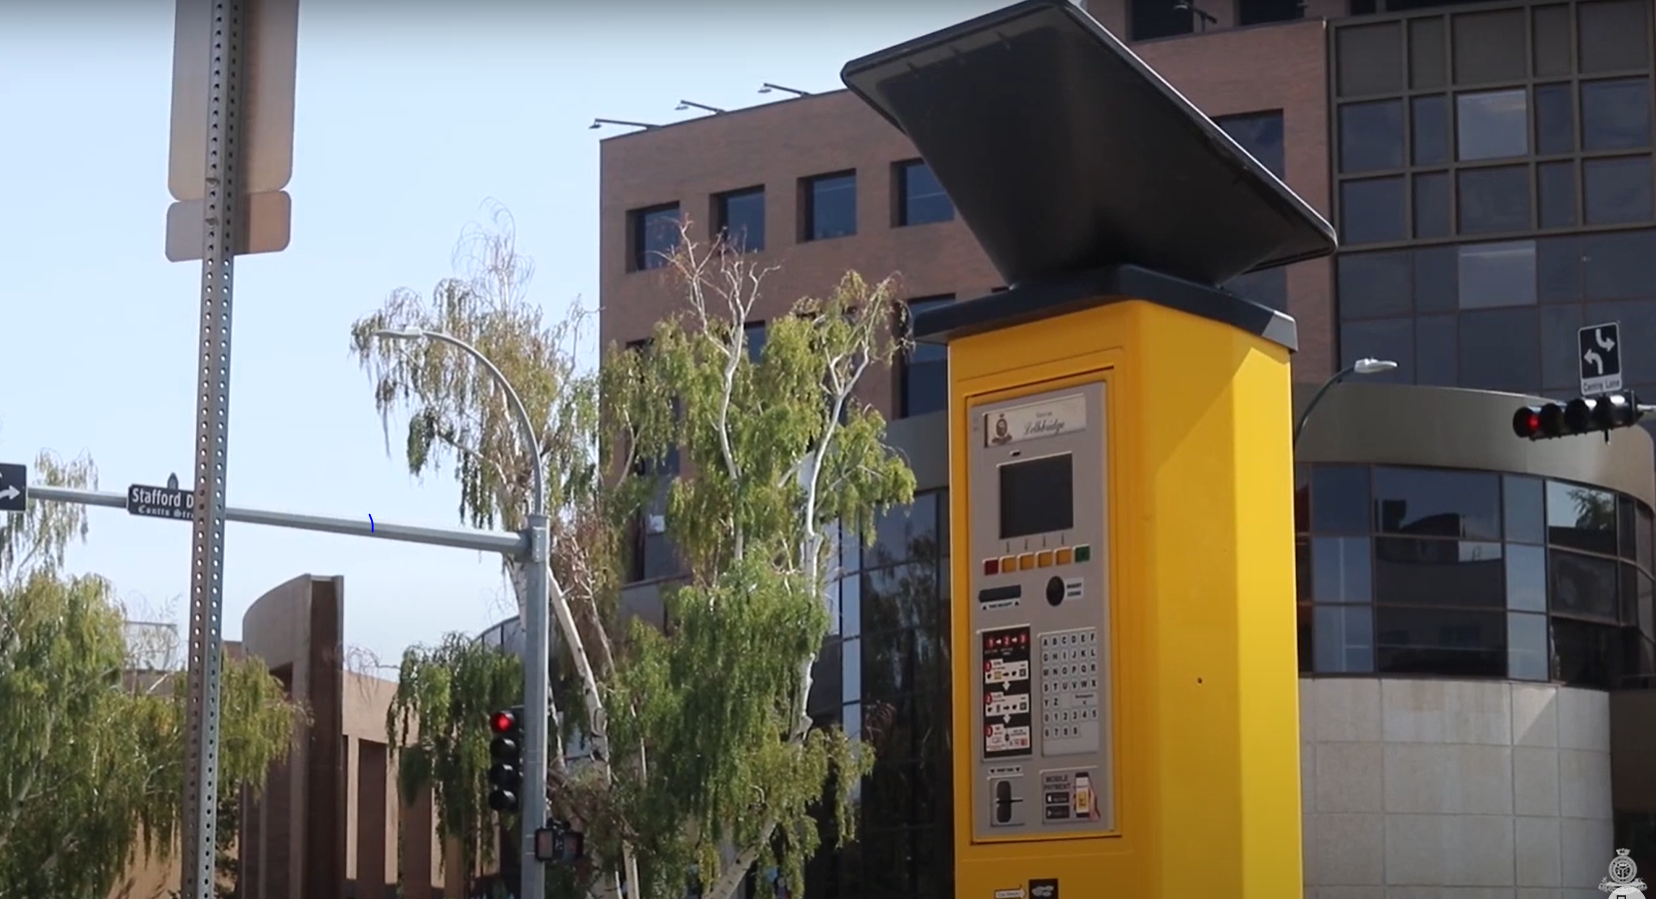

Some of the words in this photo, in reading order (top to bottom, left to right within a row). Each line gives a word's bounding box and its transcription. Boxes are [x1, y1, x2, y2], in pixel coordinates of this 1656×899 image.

[132, 488, 181, 507] Stafford
[186, 494, 194, 508] D
[173, 508, 194, 518] Str
